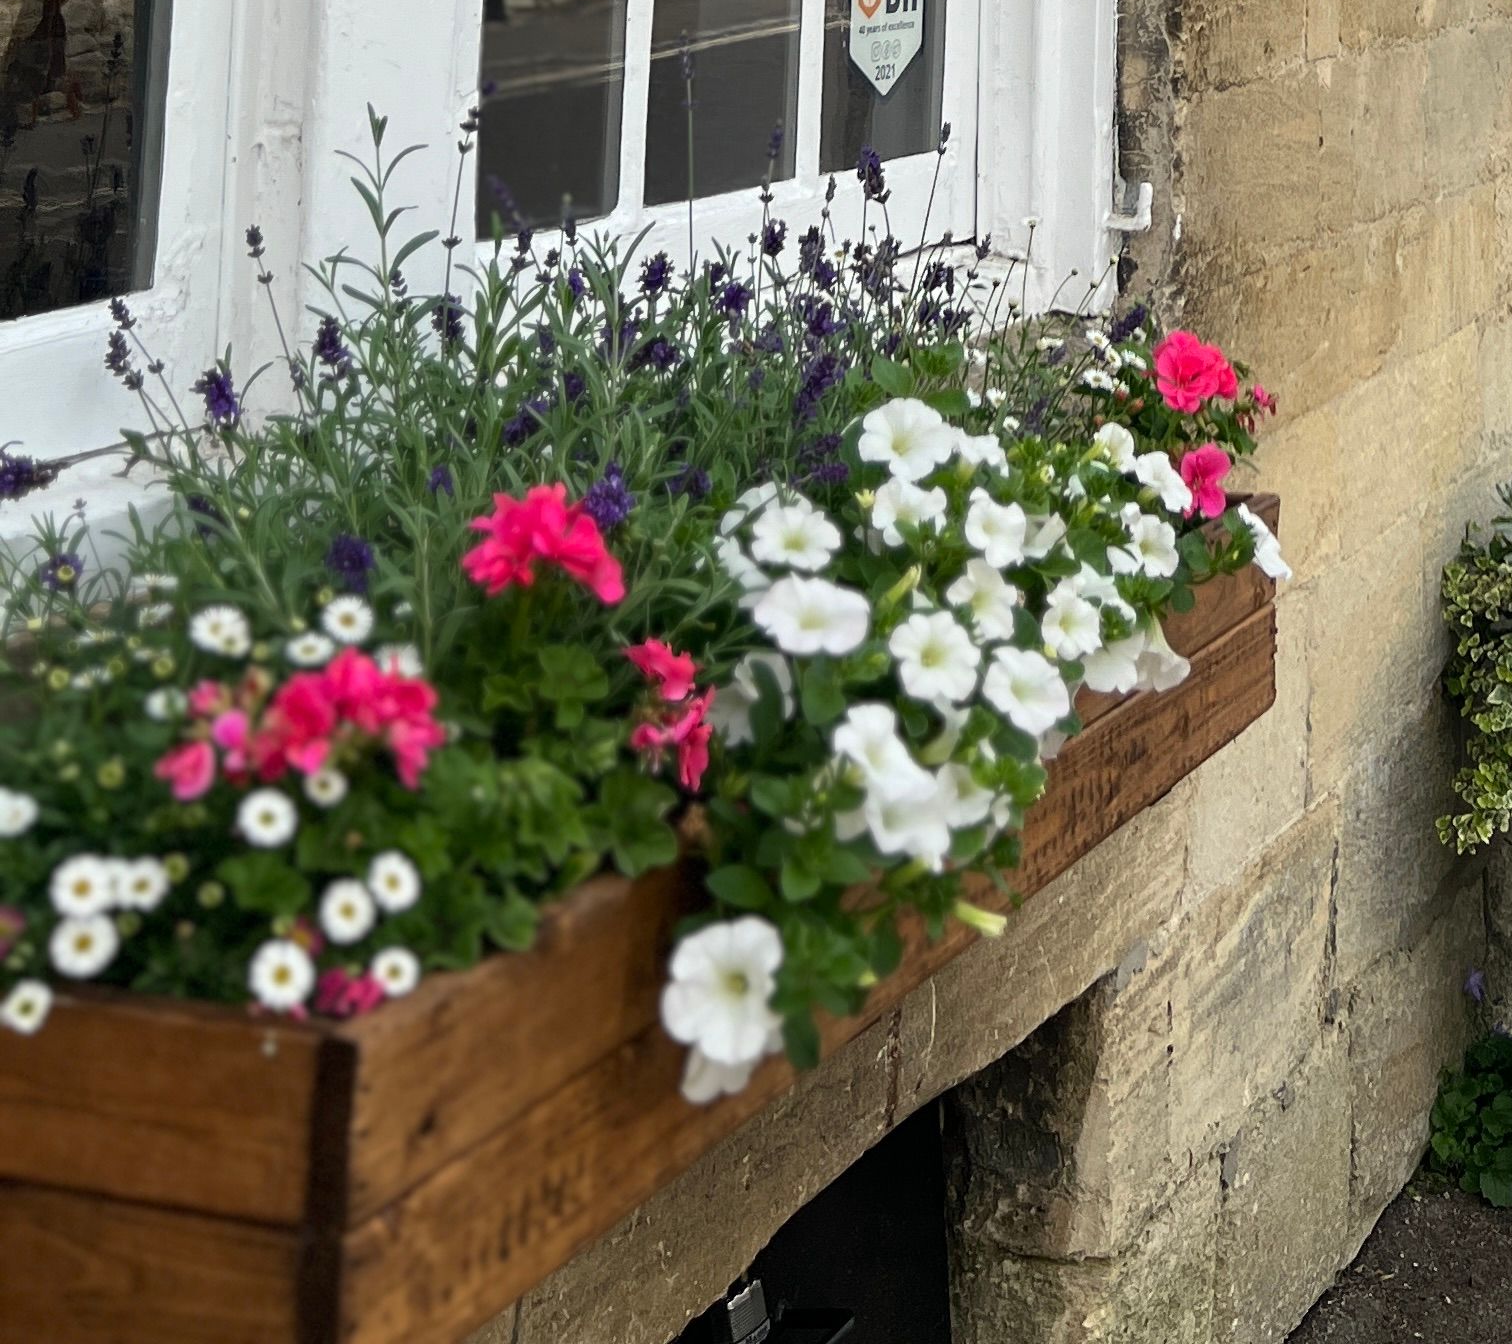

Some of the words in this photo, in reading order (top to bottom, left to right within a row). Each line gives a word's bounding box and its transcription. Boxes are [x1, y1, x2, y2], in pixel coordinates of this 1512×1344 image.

[866, 25, 881, 37] years
[888, 20, 915, 31] excellence
[875, 63, 896, 81] 2021
